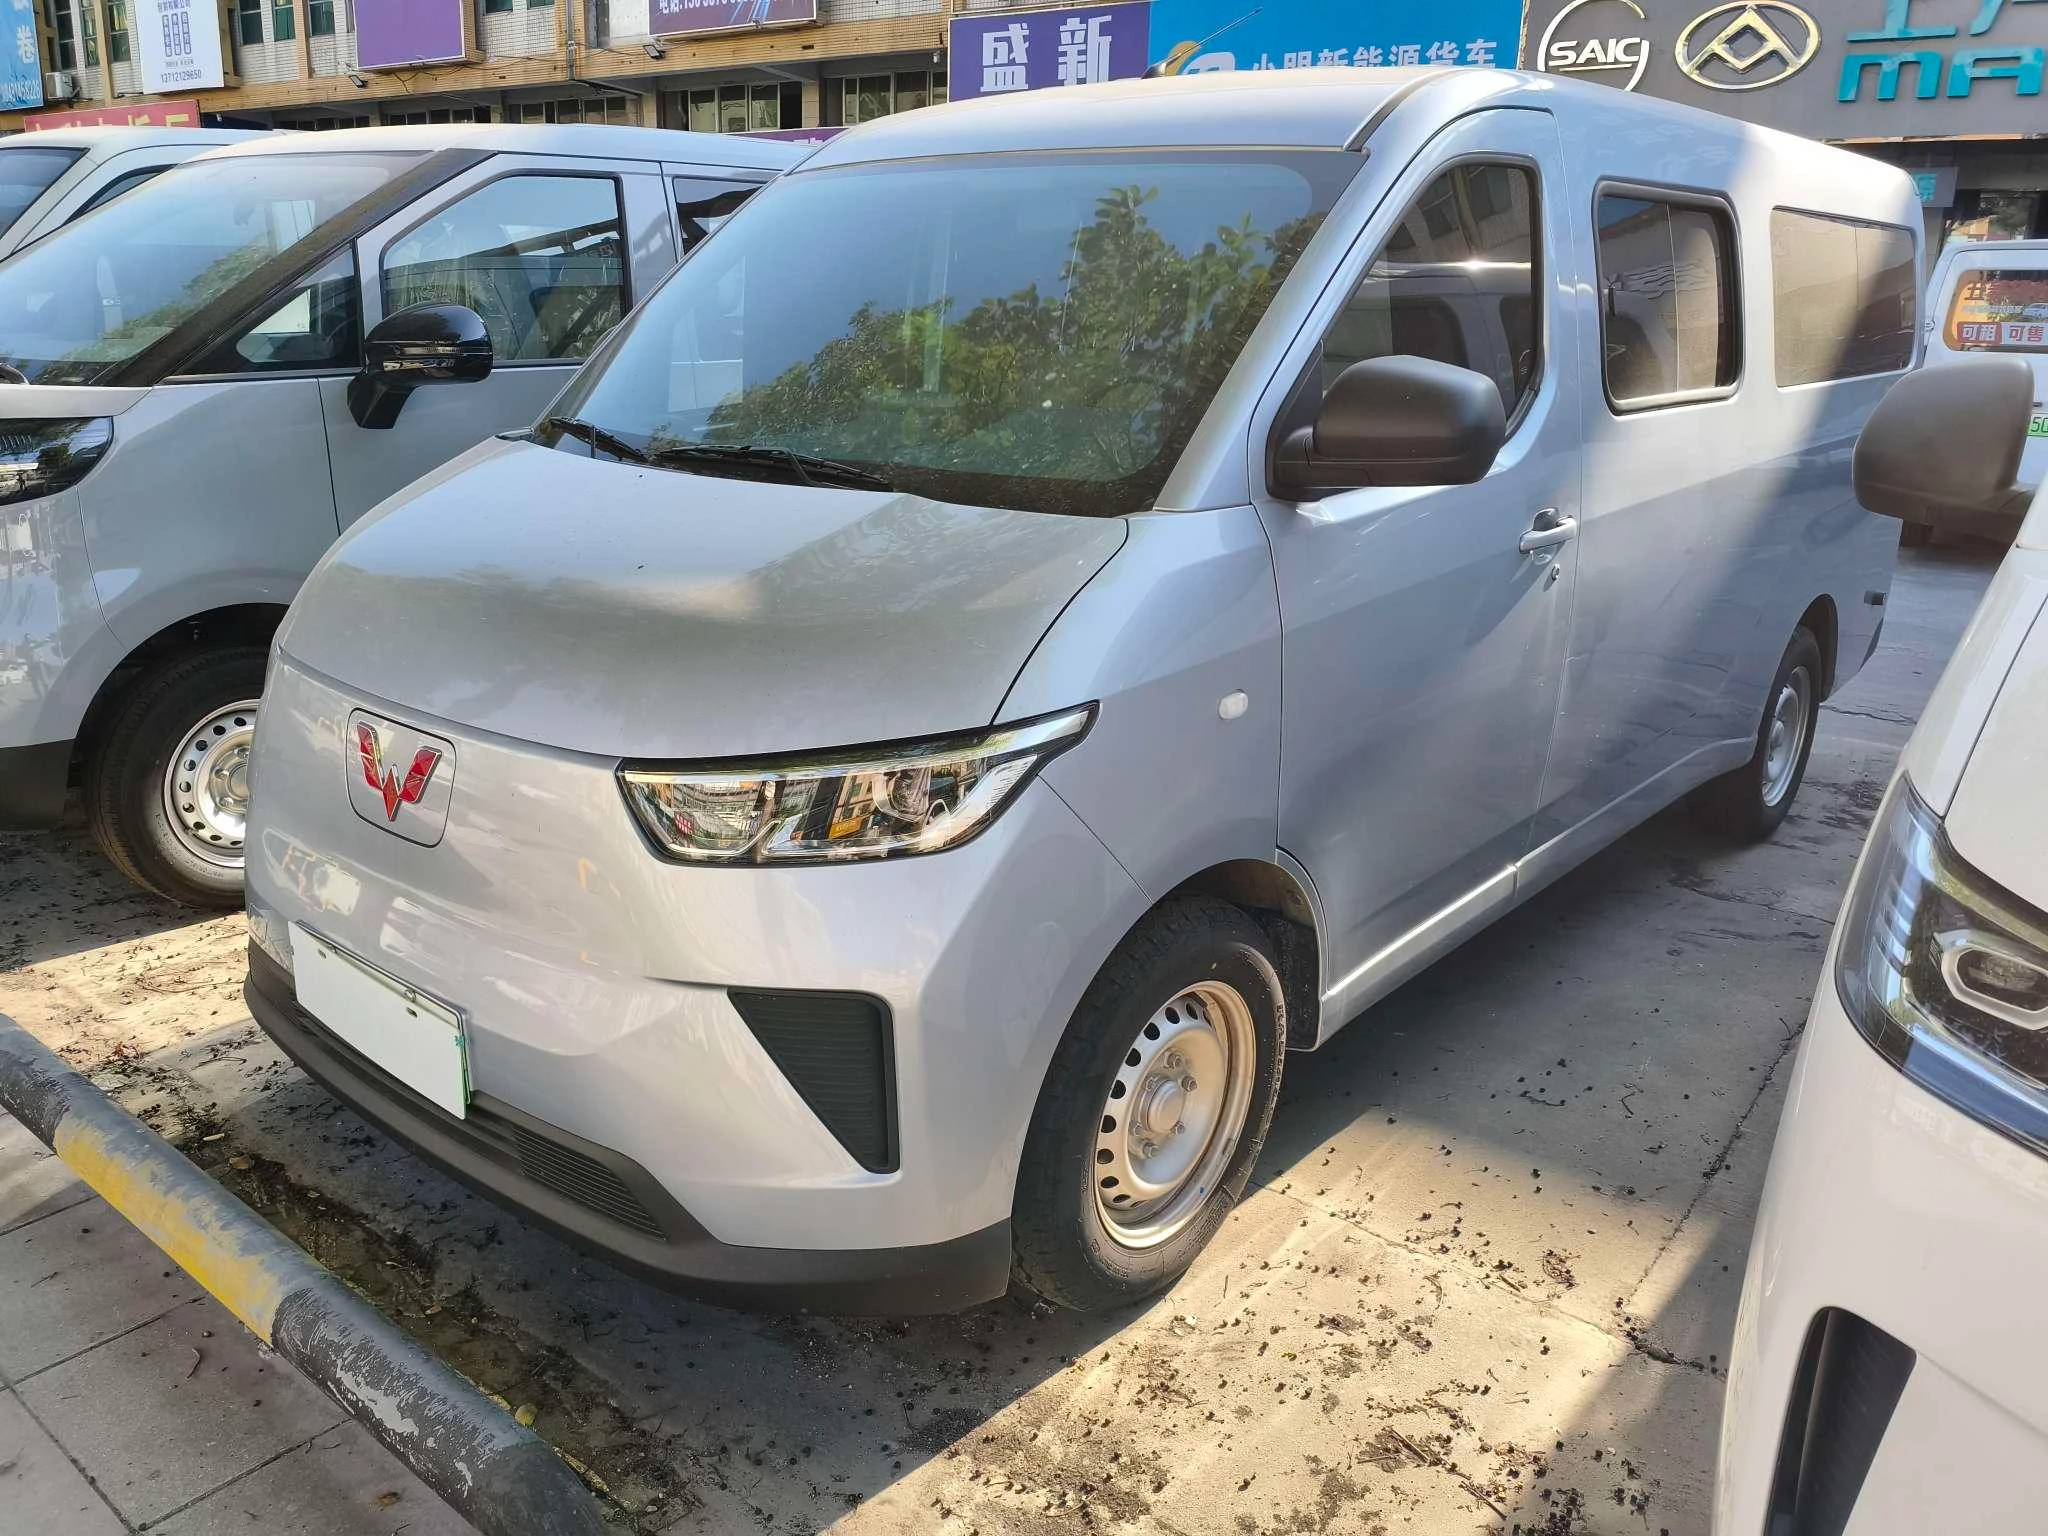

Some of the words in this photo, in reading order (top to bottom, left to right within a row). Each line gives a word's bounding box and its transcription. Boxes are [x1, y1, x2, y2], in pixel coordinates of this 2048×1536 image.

[980, 15, 1113, 92] 盛新
[1253, 38, 1498, 70] 小明新能源货车
[1549, 37, 1640, 67] SAIC
[2009, 325, 2045, 342] 可售
